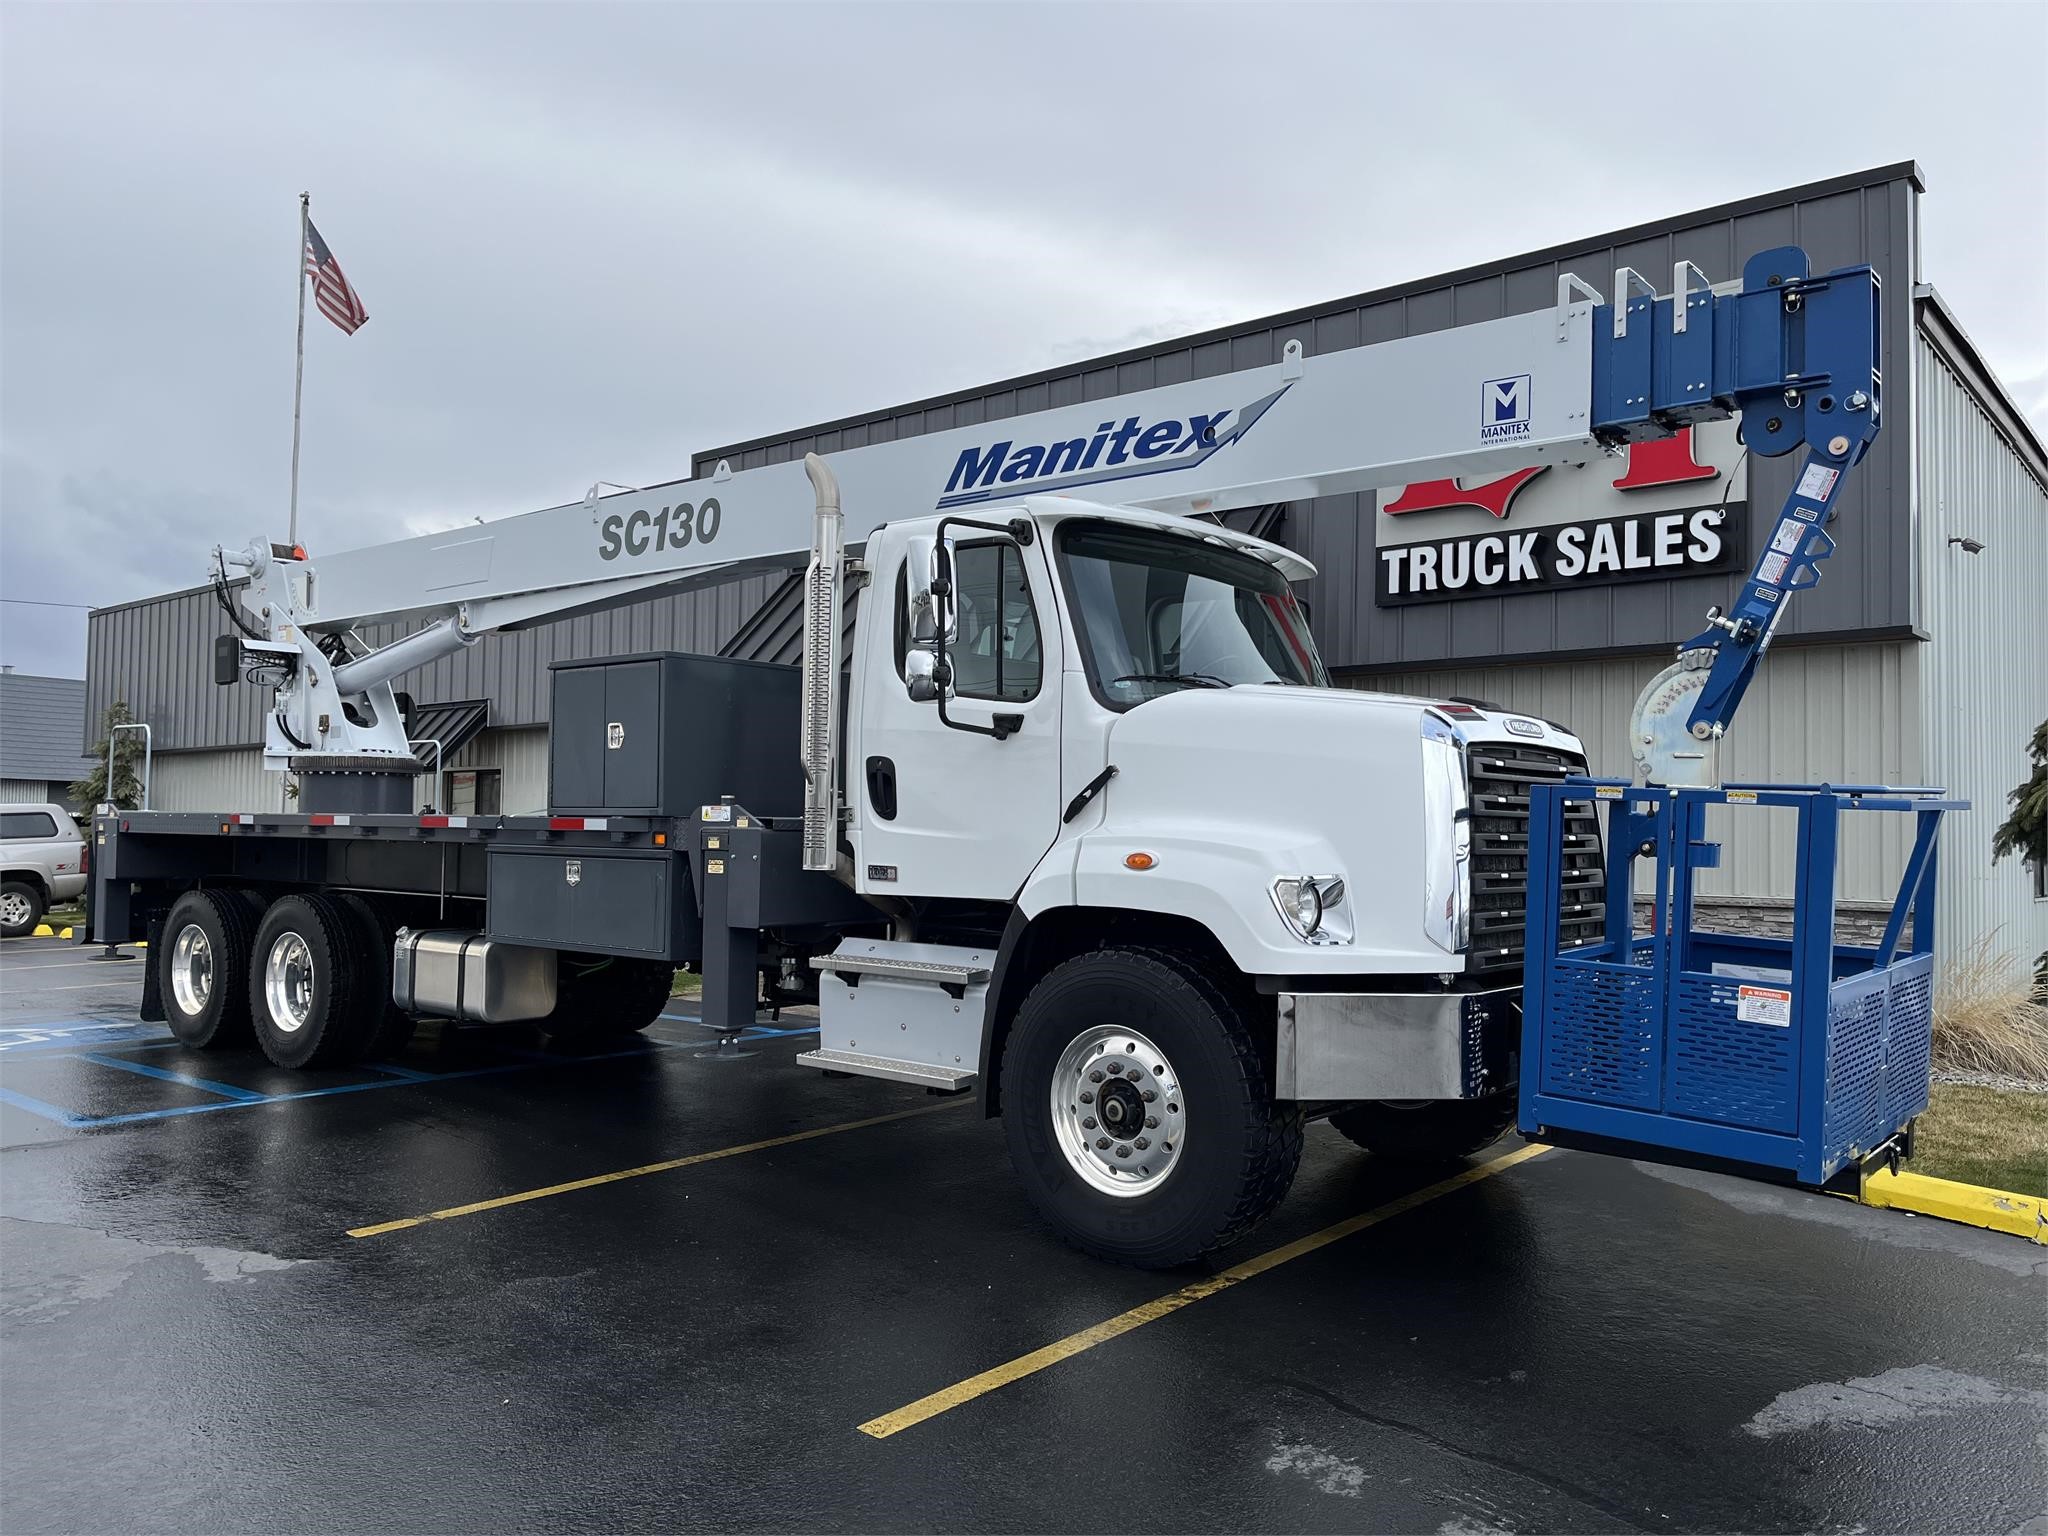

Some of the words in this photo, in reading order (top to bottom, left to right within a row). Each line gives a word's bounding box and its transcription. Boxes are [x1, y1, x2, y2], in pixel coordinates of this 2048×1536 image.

[944, 409, 1233, 493] Manitex
[1481, 421, 1530, 439] MANITEX
[1481, 434, 1530, 446] INTERNATIONAL
[599, 498, 721, 560] SC130
[1382, 532, 1539, 594] TRUCK
[1555, 509, 1722, 577] SALES
